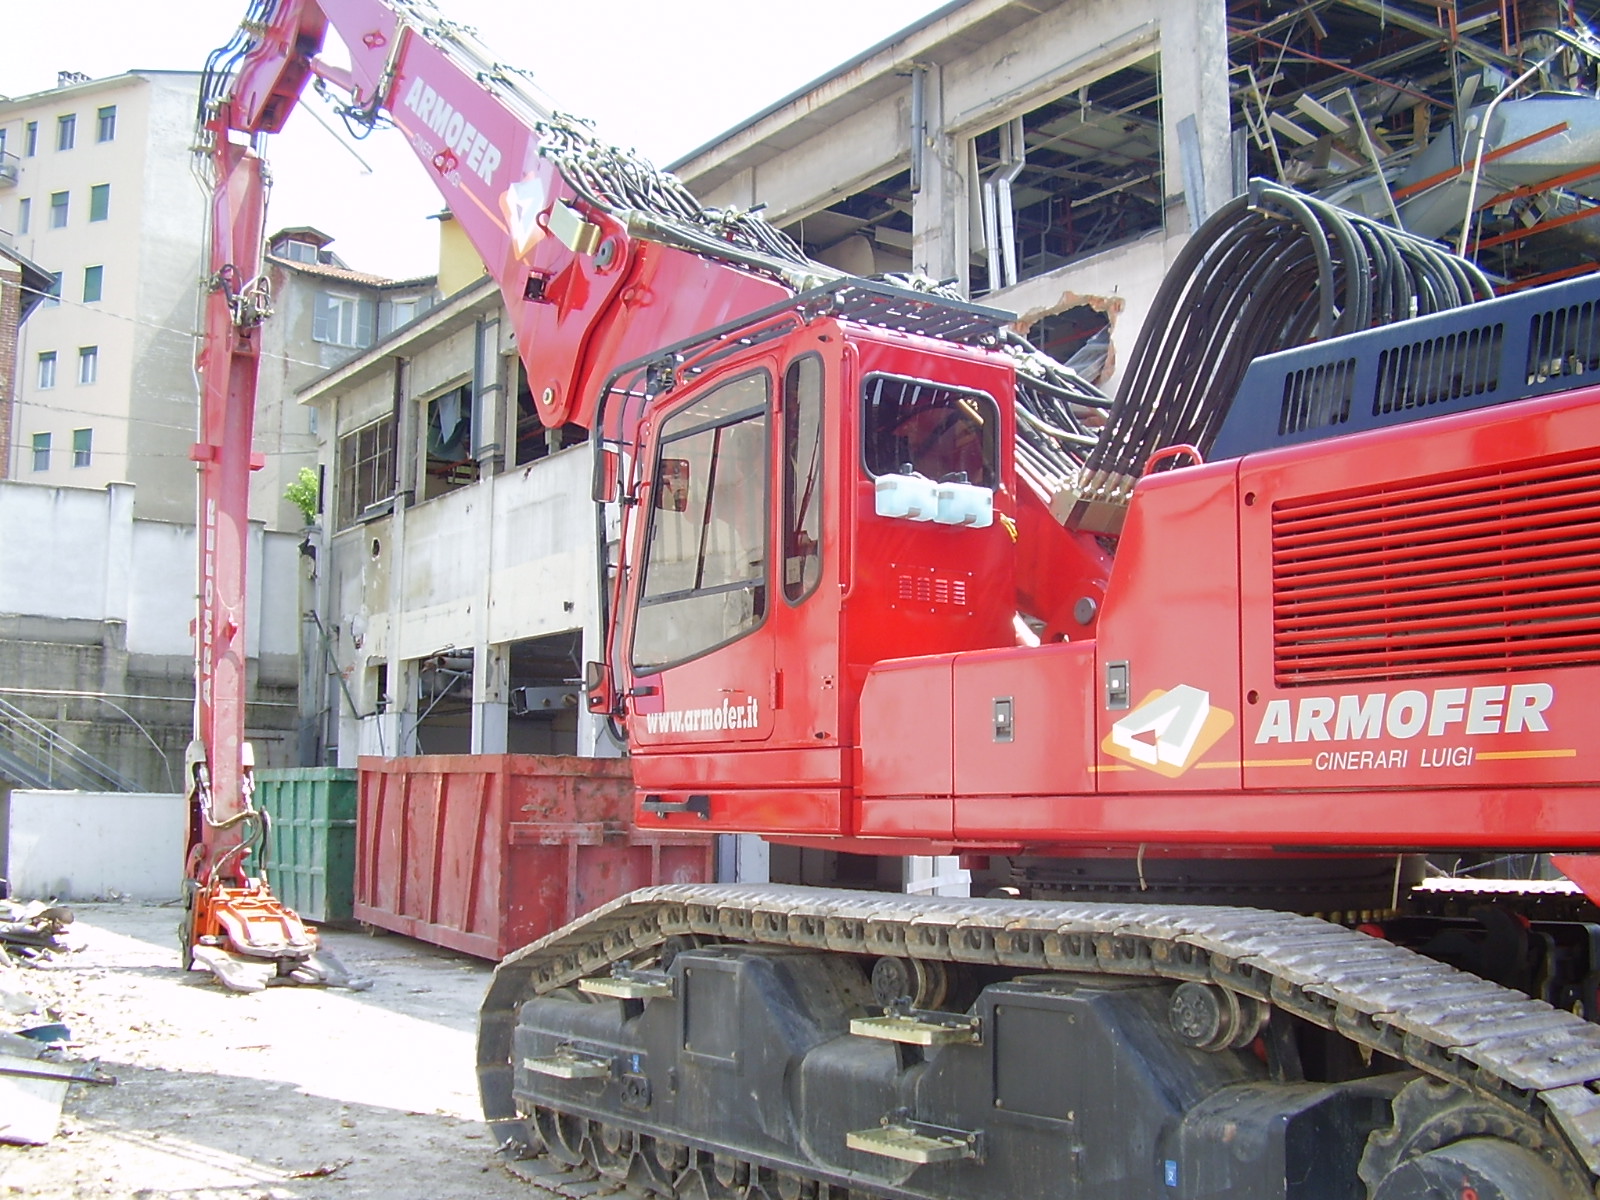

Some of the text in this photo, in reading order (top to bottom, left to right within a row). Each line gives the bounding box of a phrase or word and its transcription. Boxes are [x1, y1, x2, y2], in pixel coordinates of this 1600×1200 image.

[404, 76, 502, 187] ARMOFER
[203, 498, 216, 707] ARMOFER
[646, 695, 758, 734] www.armofer.it
[1254, 682, 1554, 744] ARMOFER
[1315, 746, 1474, 771] CINERARI LUIGI
